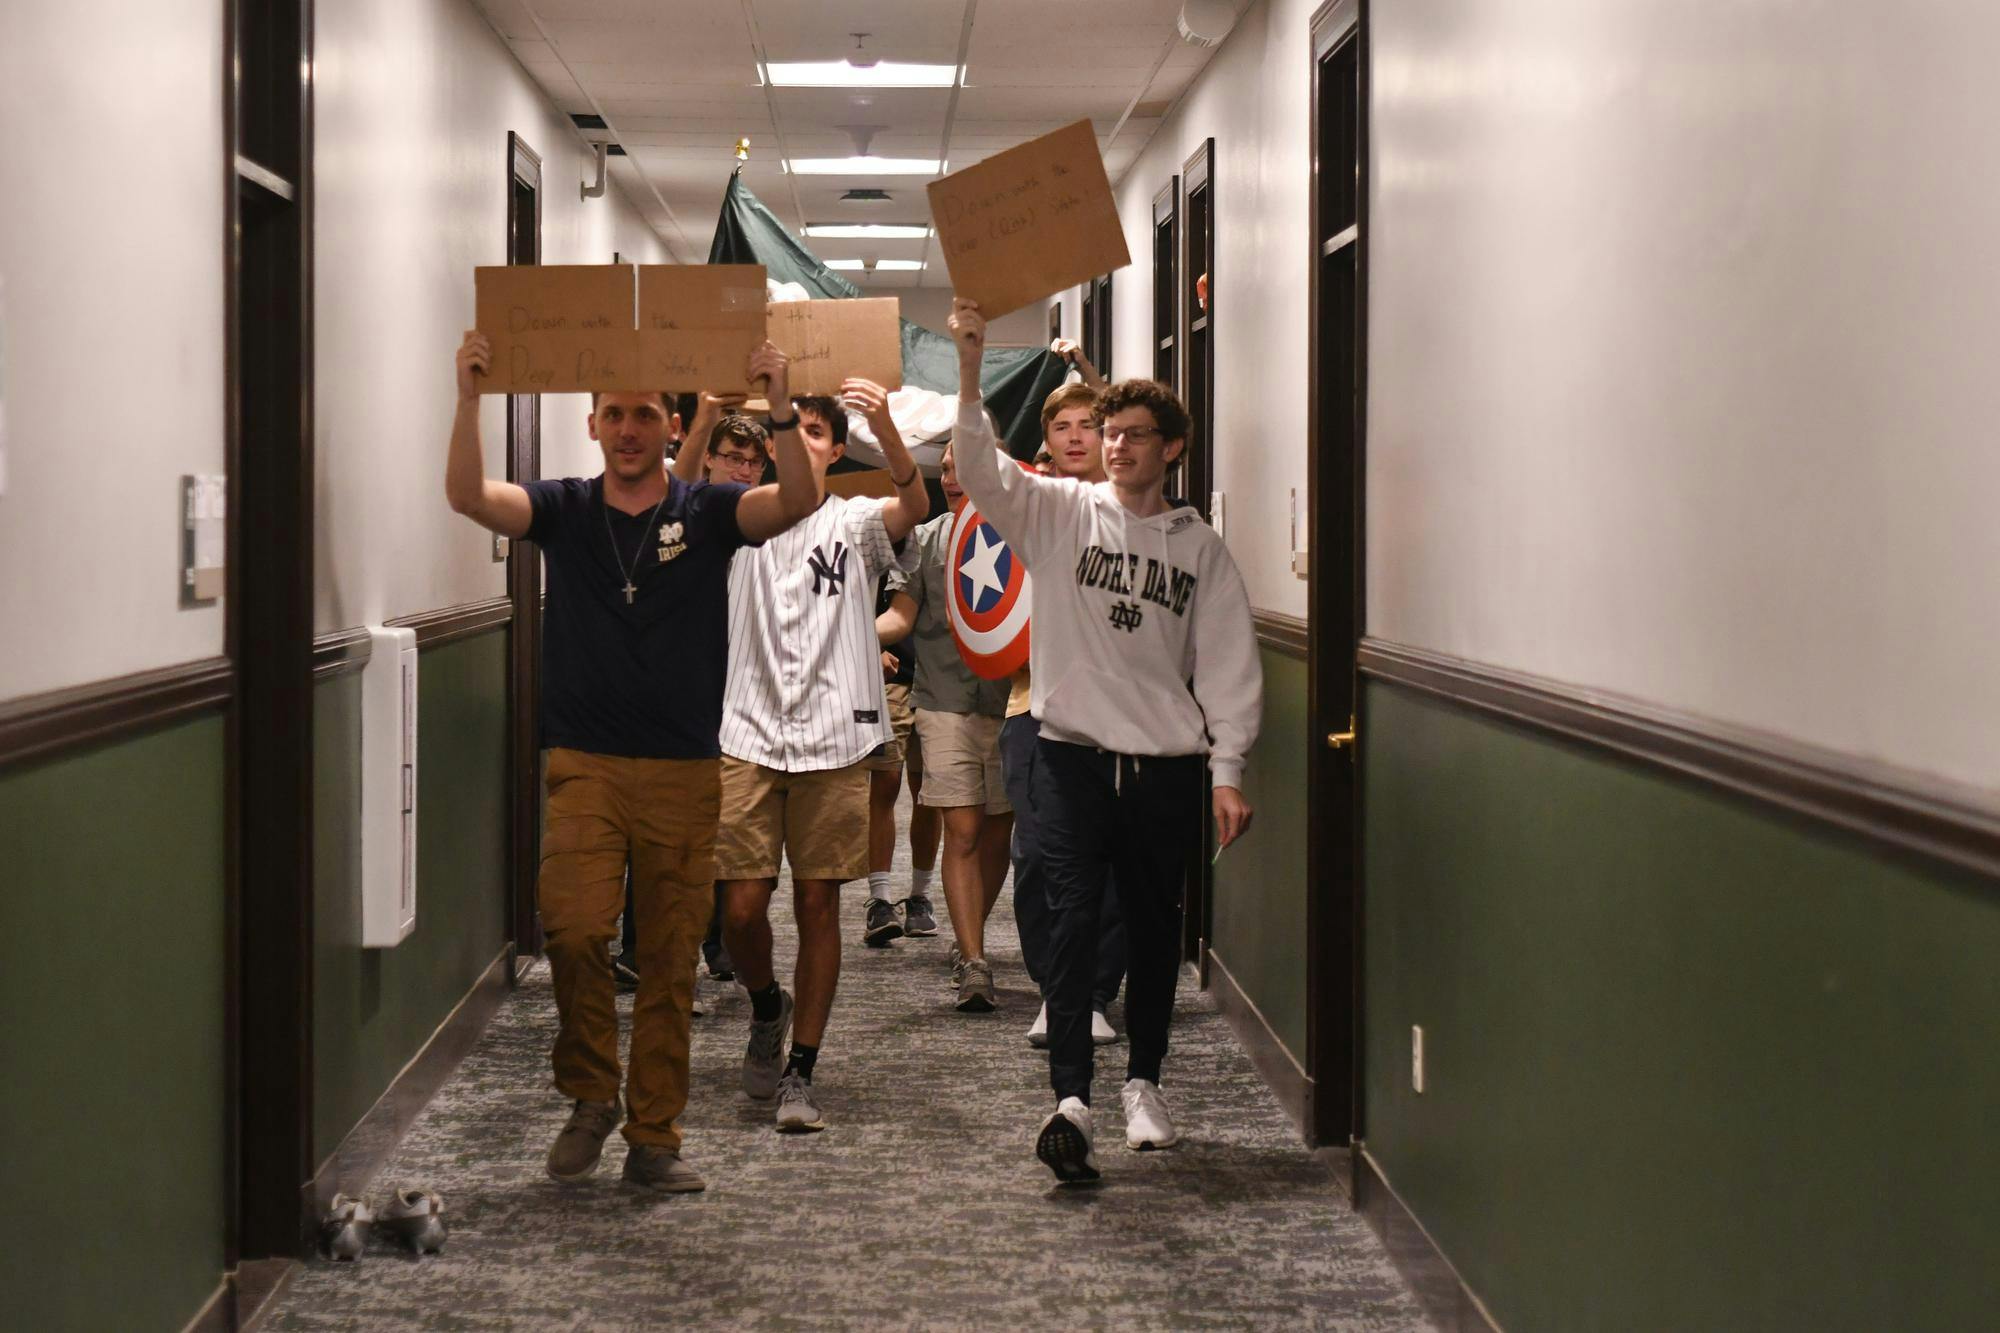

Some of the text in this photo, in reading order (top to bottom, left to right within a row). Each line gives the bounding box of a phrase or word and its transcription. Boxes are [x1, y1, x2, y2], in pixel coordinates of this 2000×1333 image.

[942, 193, 1006, 227] Down
[508, 306, 568, 334] Down
[510, 344, 556, 387] Deep
[1076, 545, 1197, 618] NOTRE DAME
